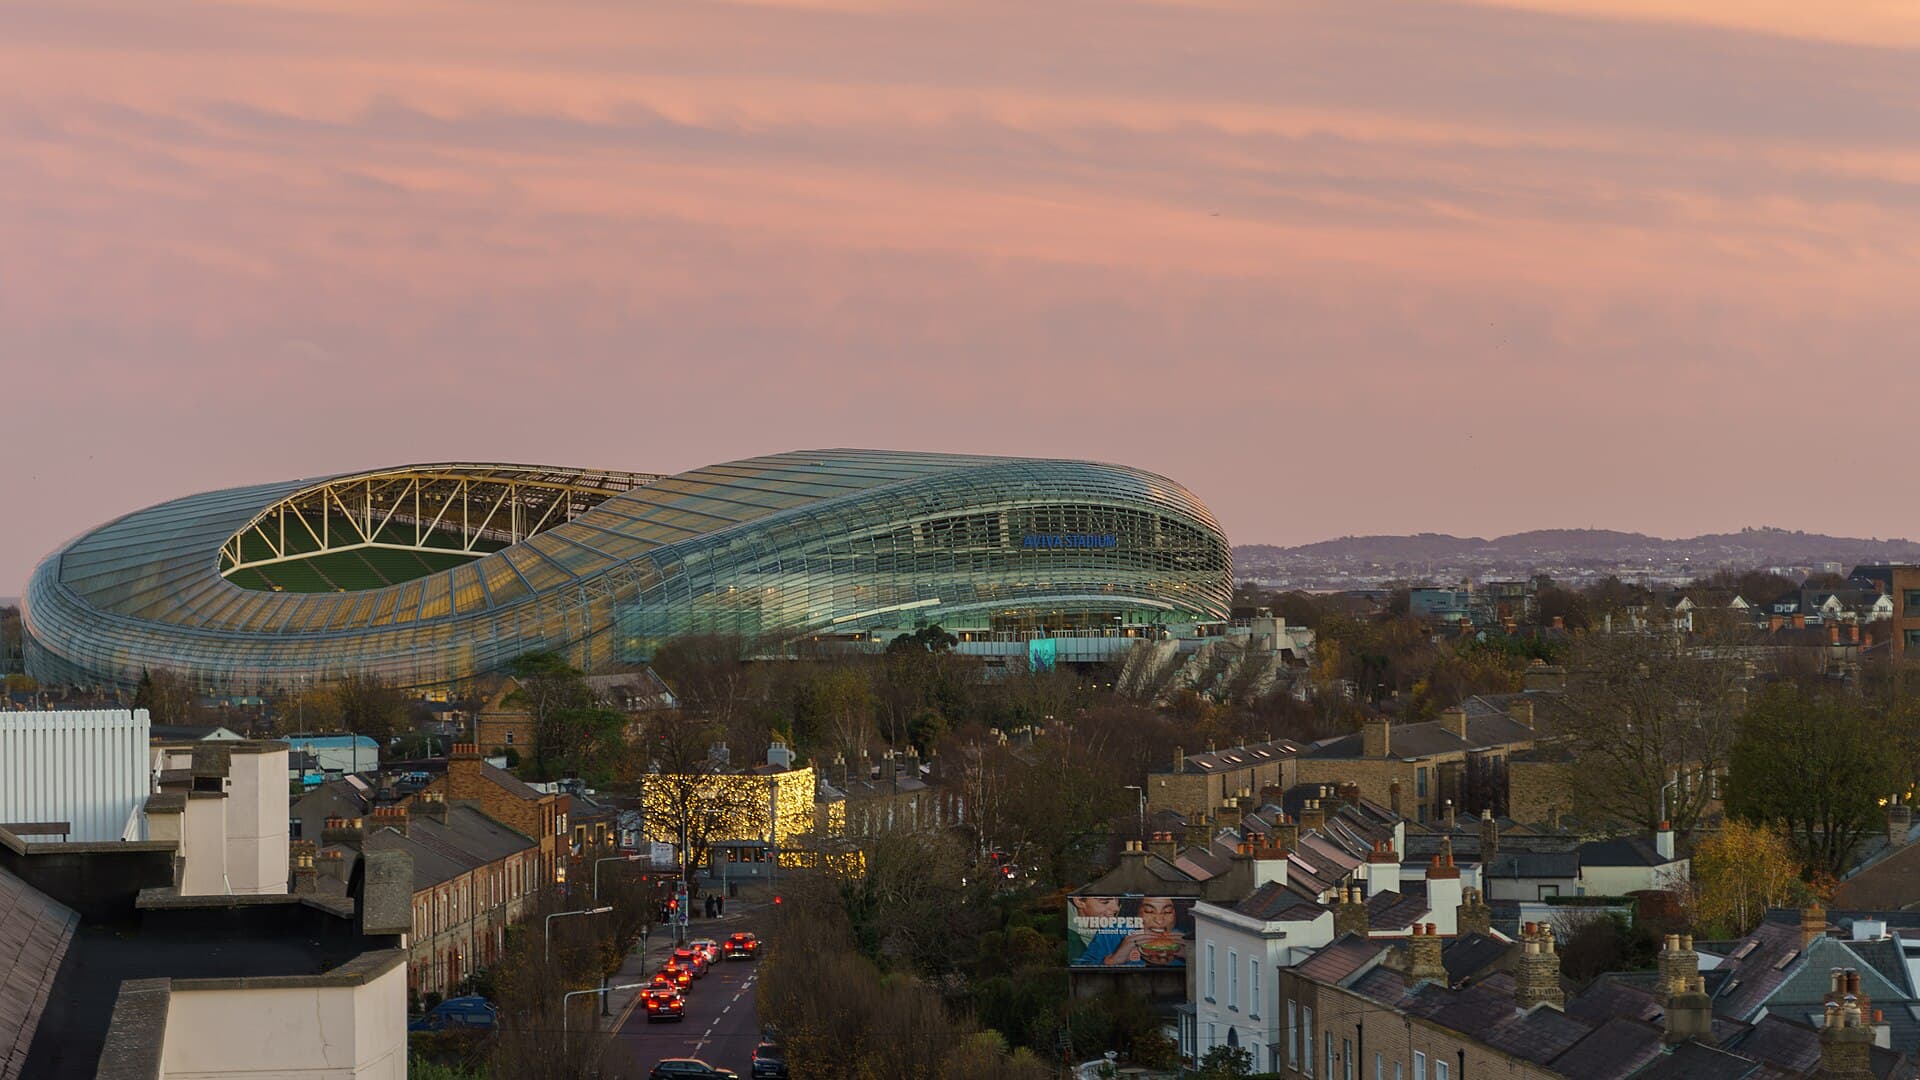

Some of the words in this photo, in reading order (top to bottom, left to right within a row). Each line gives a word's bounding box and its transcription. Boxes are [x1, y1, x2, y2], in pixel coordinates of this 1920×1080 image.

[1024, 535, 1062, 548] AVIVA
[1064, 535, 1116, 548] STADIUM
[1073, 917, 1144, 928] WHOPPER
